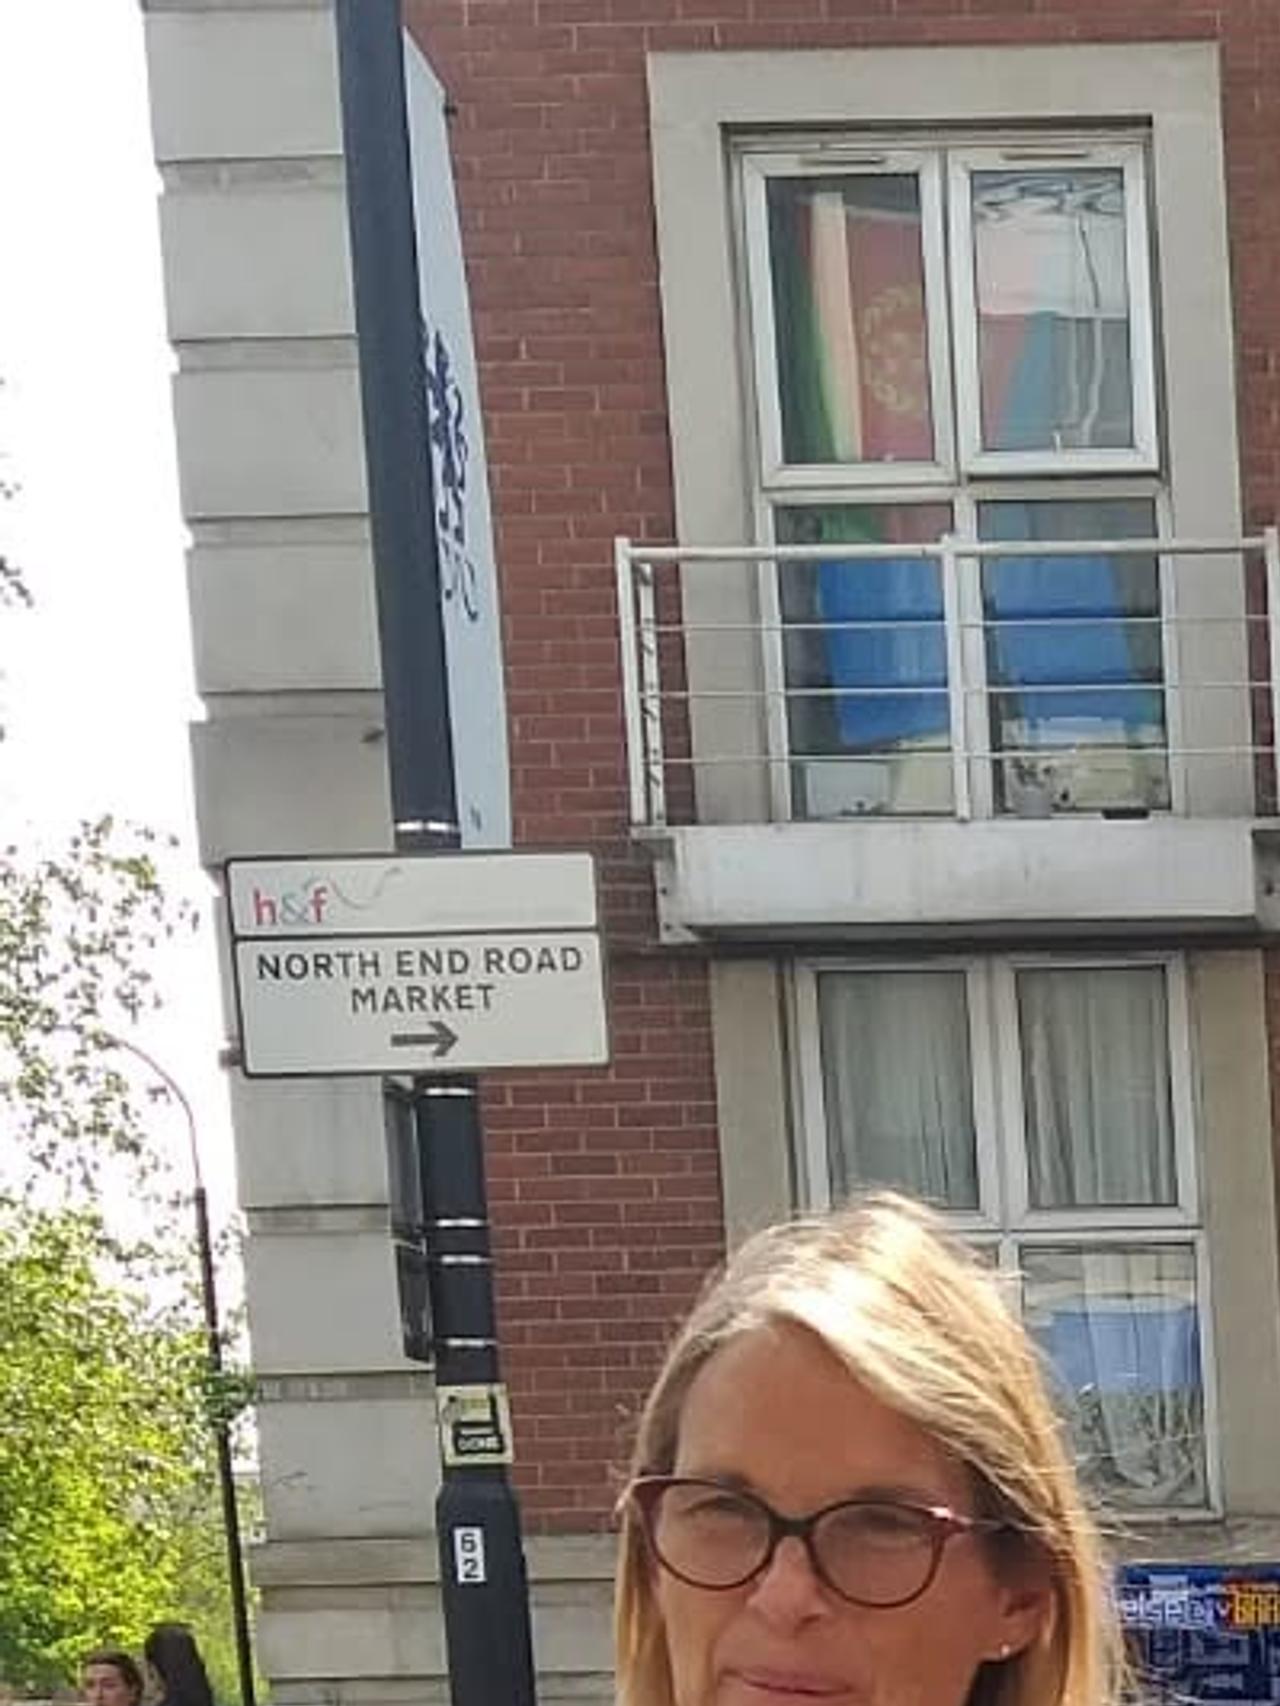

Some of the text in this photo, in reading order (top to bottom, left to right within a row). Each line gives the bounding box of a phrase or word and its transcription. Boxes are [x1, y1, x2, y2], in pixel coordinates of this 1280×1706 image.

[254, 885, 328, 926] h&f
[257, 946, 583, 981] NORTH END ROAD
[351, 984, 496, 1014] MARKET
